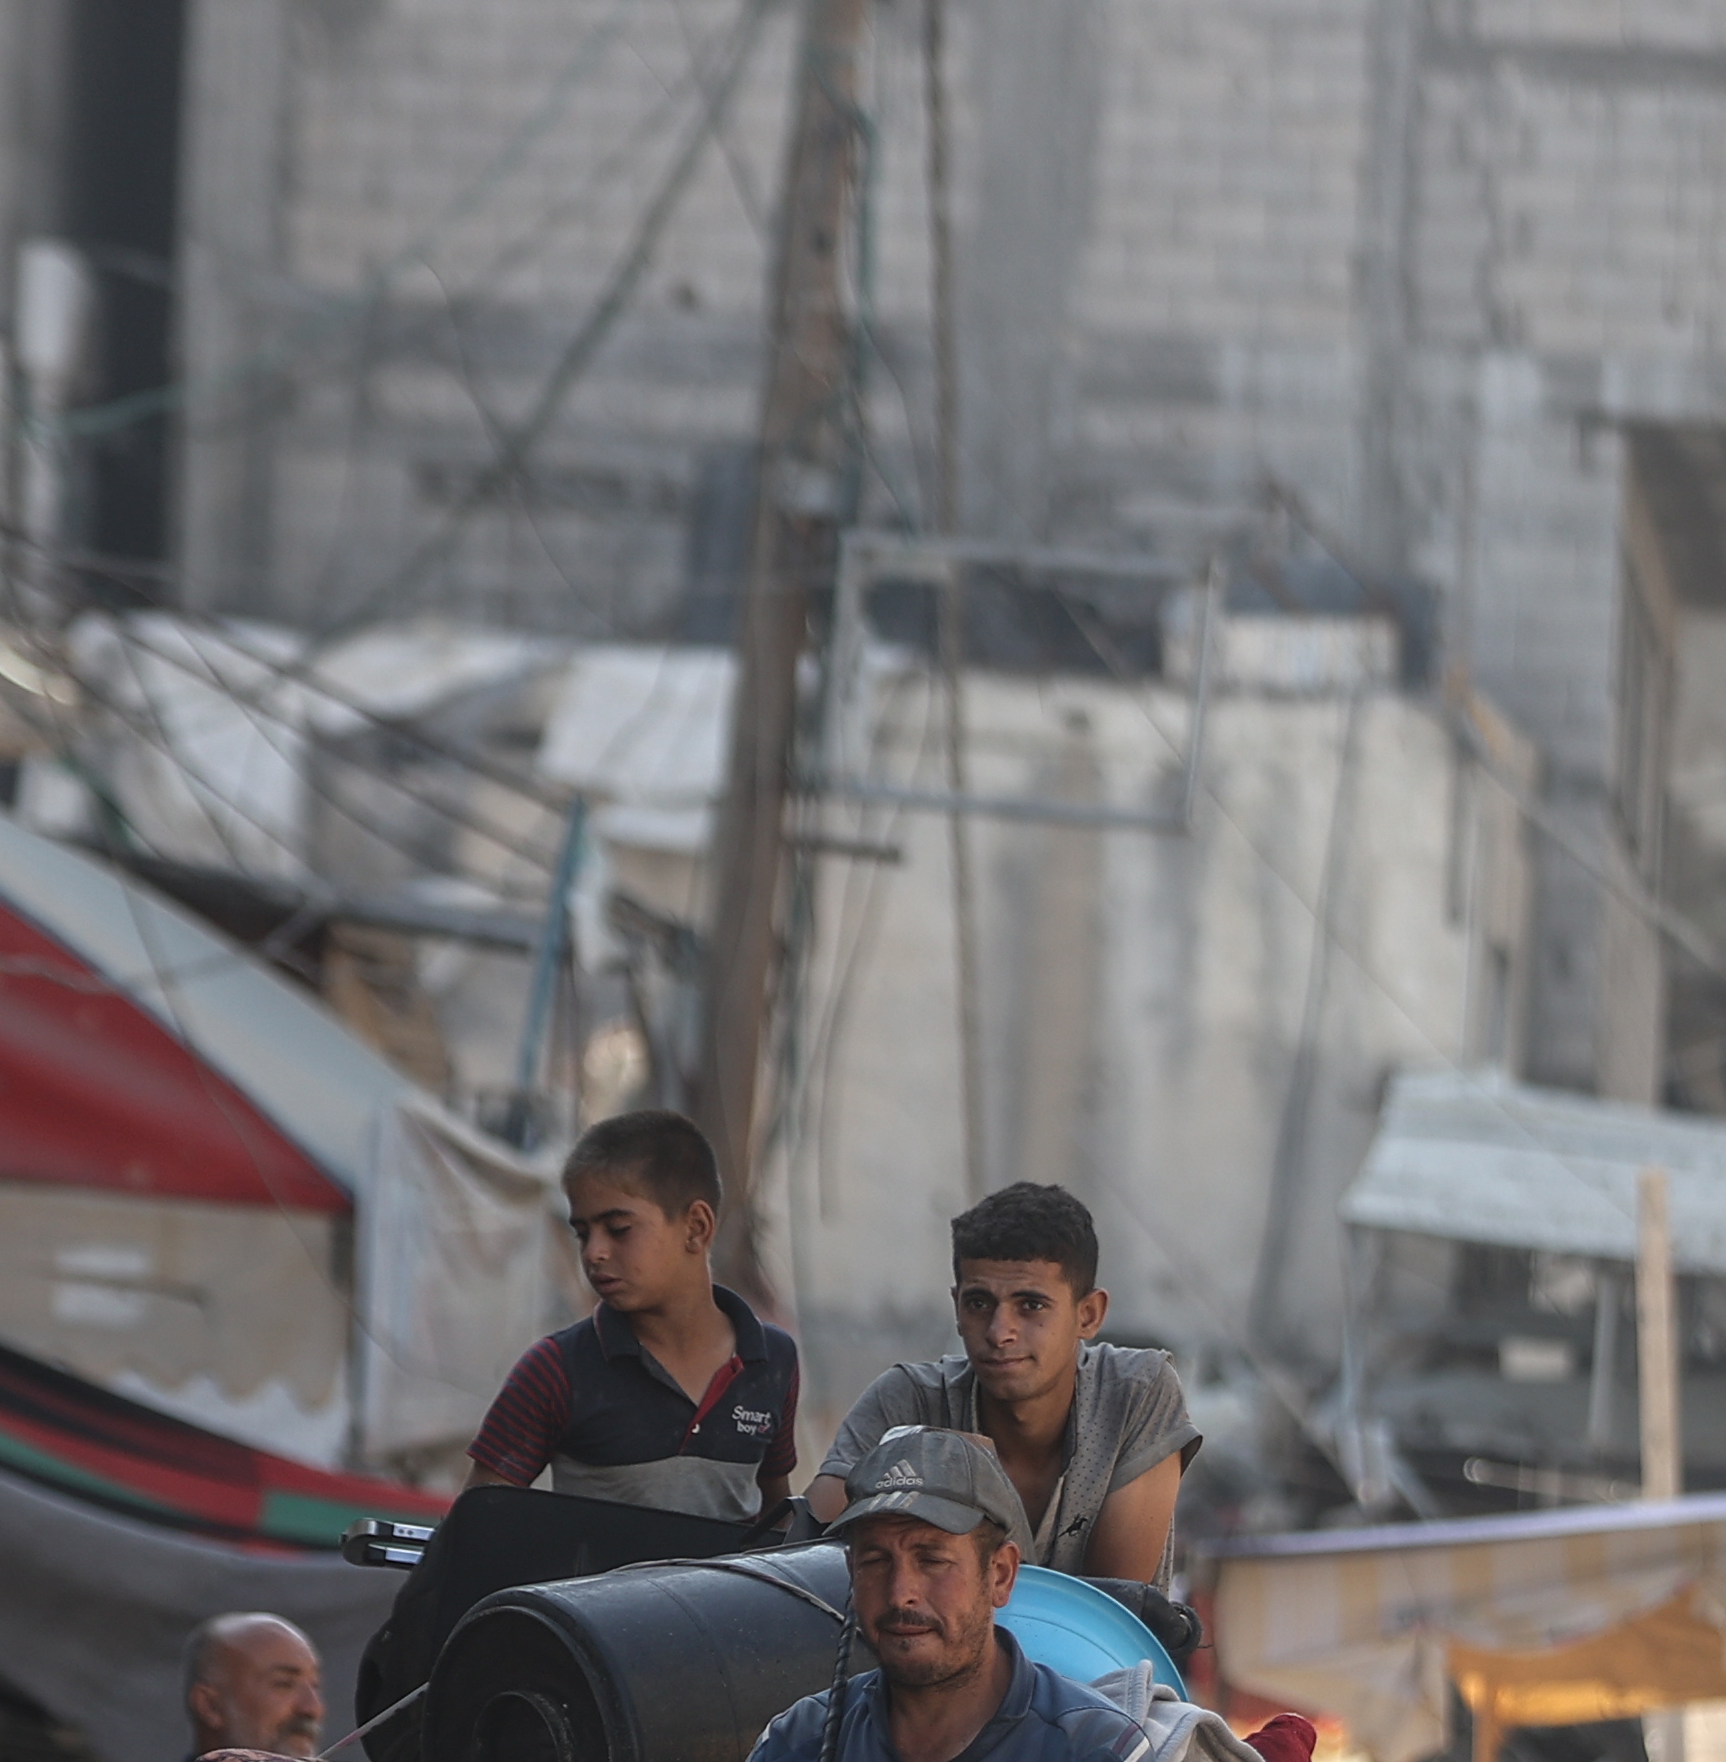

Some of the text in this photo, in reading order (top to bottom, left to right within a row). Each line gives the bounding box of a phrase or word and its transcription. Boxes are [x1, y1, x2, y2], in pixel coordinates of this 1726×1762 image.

[732, 1405, 771, 1425] Smart
[737, 1420, 757, 1436] boy
[875, 1476, 924, 1489] adidas
